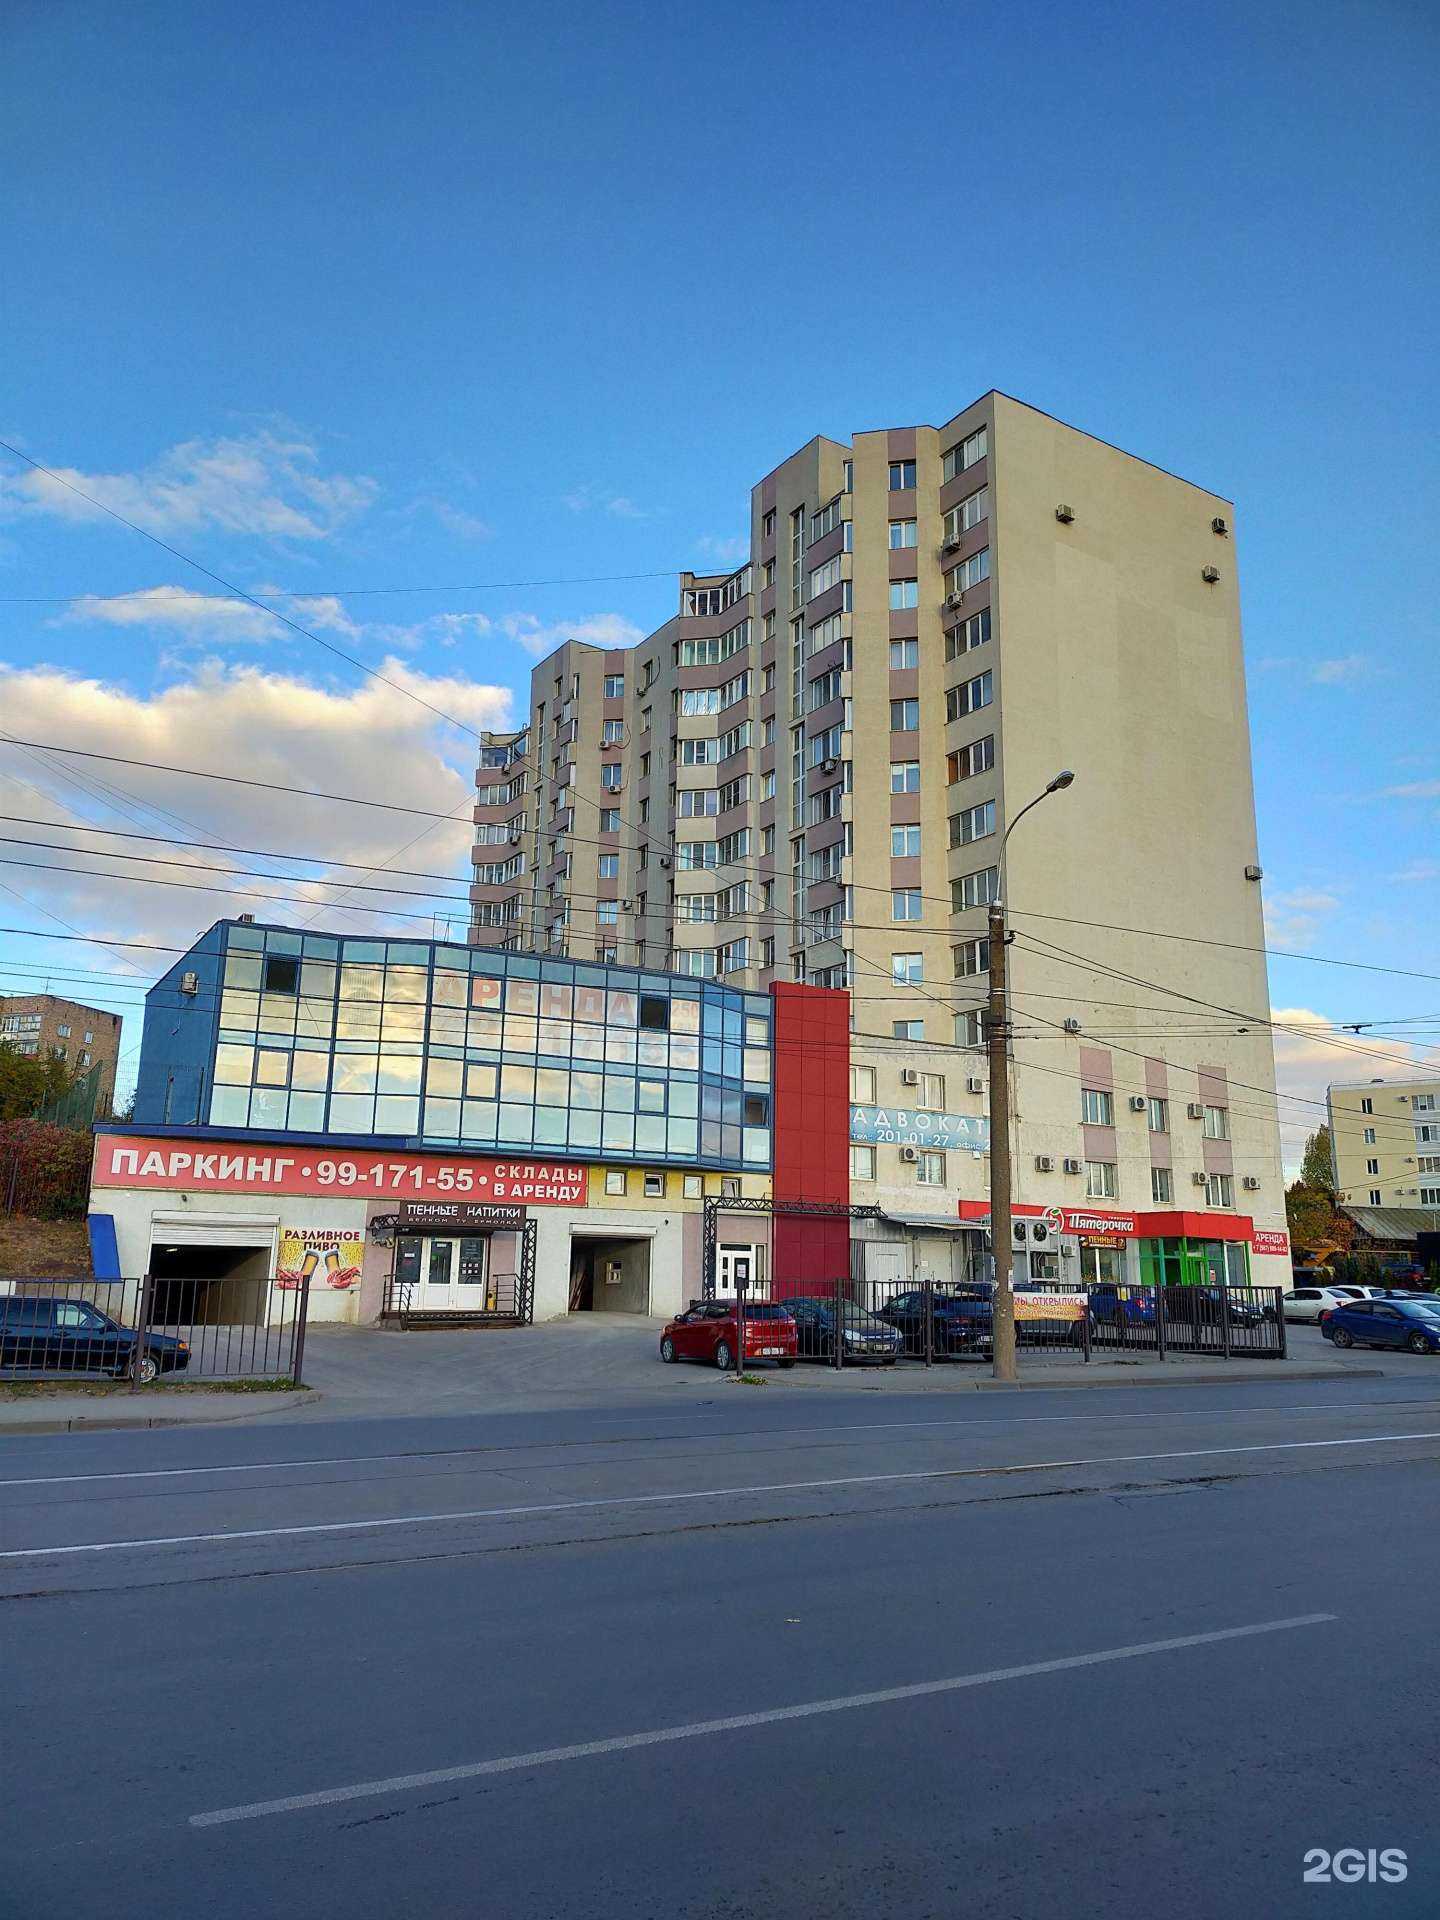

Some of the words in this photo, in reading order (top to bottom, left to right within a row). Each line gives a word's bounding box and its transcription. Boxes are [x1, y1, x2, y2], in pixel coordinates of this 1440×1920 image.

[435, 973, 635, 1022] АРЕНДА
[853, 1108, 984, 1135] АДВОКАТ
[111, 1149, 295, 1182] ПАРКИНГ
[316, 1160, 474, 1191] 99-171-55
[494, 1164, 583, 1184] СКЛАДЫ
[493, 1184, 504, 1196] В
[510, 1184, 582, 1200] АРЕНДУ
[407, 1204, 459, 1216] ПЕННЫЕ
[467, 1206, 521, 1218] НАПИТКИ
[284, 1230, 360, 1241] РАЗЛИВНОЕ
[1088, 1235, 1117, 1245] ПЕННЫЕ
[1255, 1232, 1285, 1244] АРЕНДА
[304, 1242, 341, 1251] ПИВО
[1032, 1296, 1084, 1306] ОТКРЫЛИСЬ
